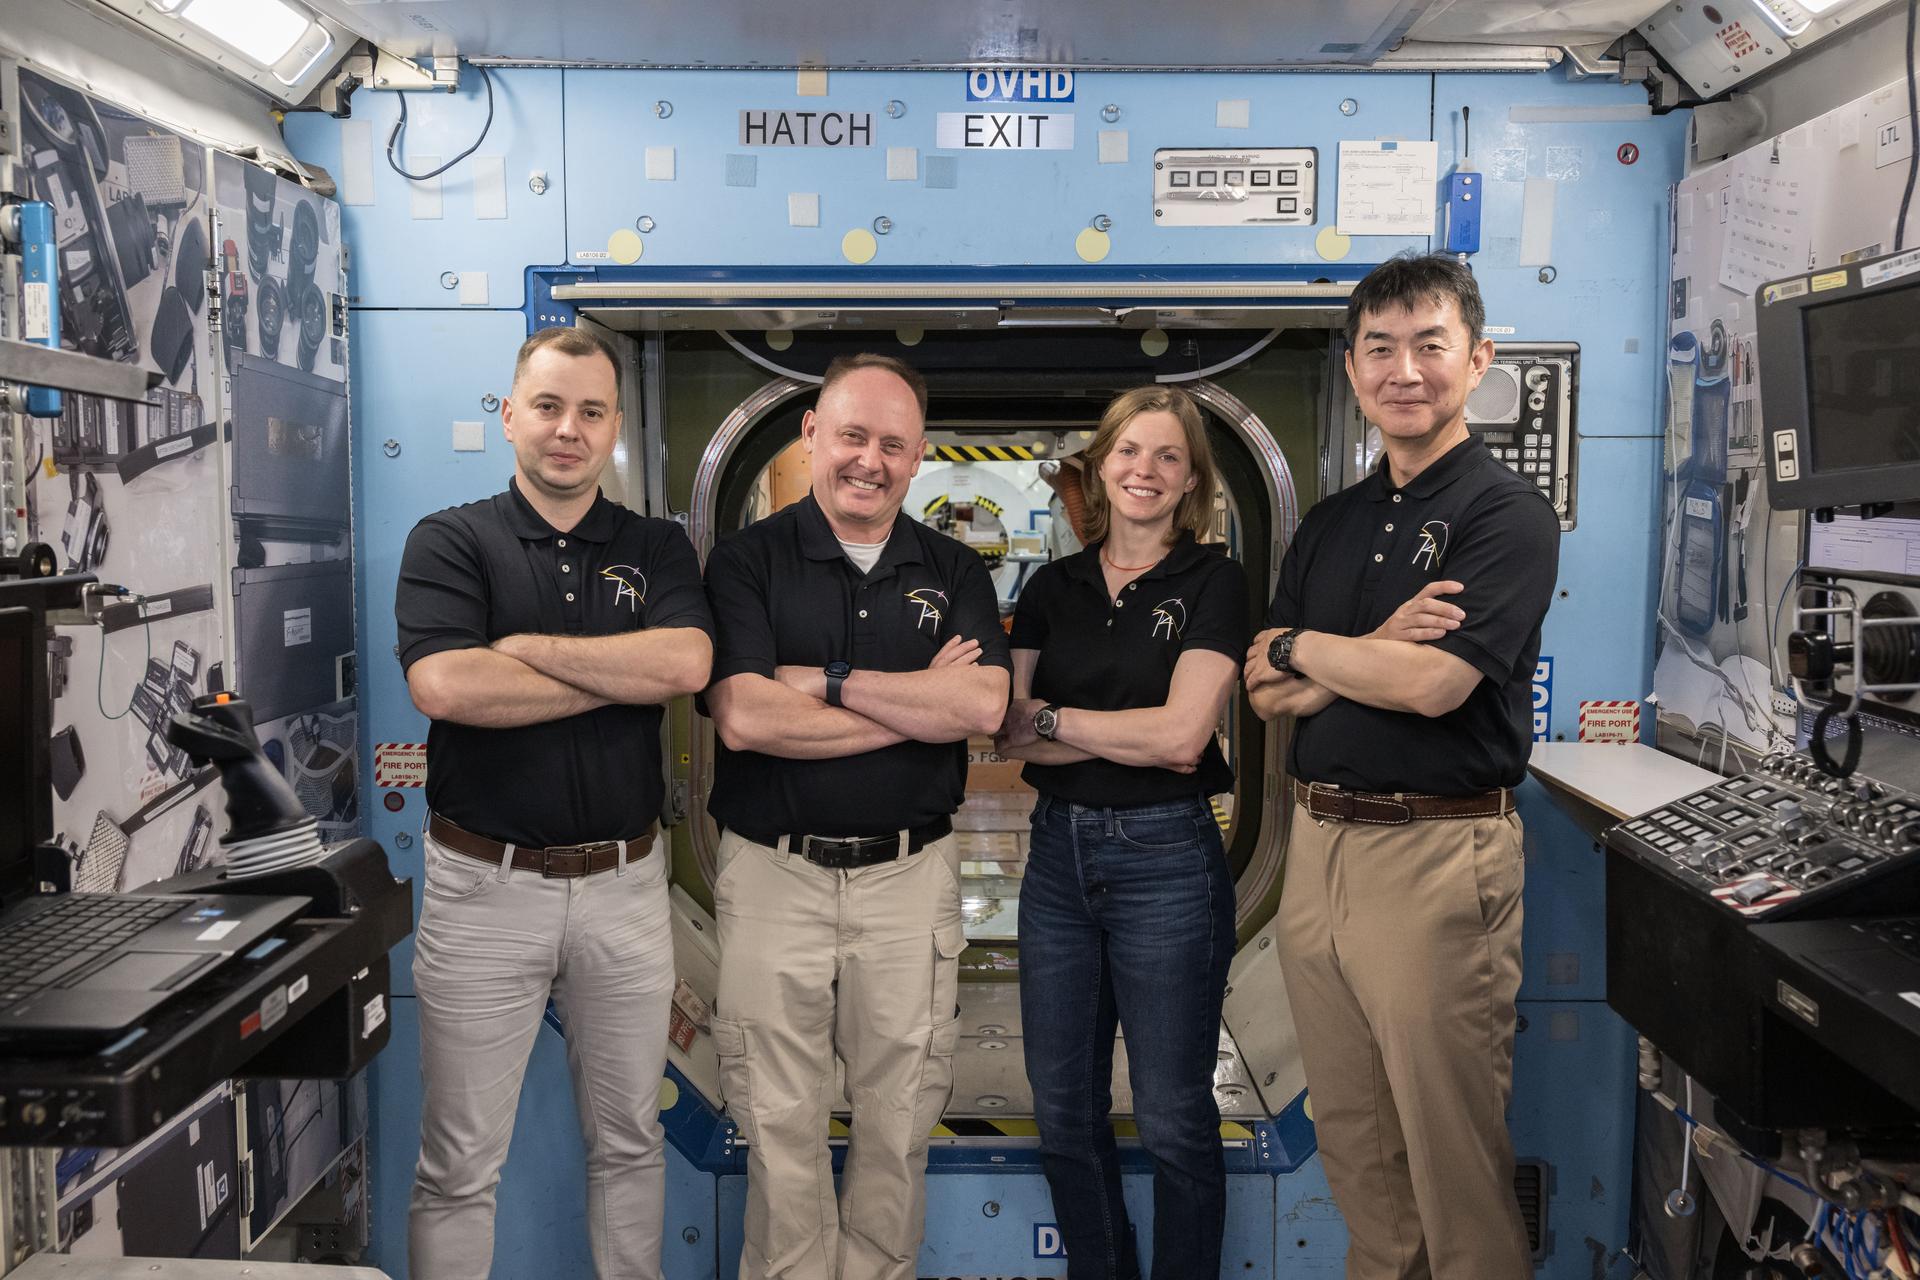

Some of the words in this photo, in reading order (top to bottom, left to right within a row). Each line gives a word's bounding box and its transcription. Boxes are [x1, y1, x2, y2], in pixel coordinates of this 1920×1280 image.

[969, 70, 1074, 99] OVHD
[745, 111, 871, 146] HATCH
[964, 115, 1049, 148] EXIT
[1533, 662, 1550, 742] POR
[1587, 719, 1607, 728] FIRE
[1608, 719, 1632, 728] PORT
[383, 762, 402, 770] FIRE
[404, 762, 427, 770] PORT
